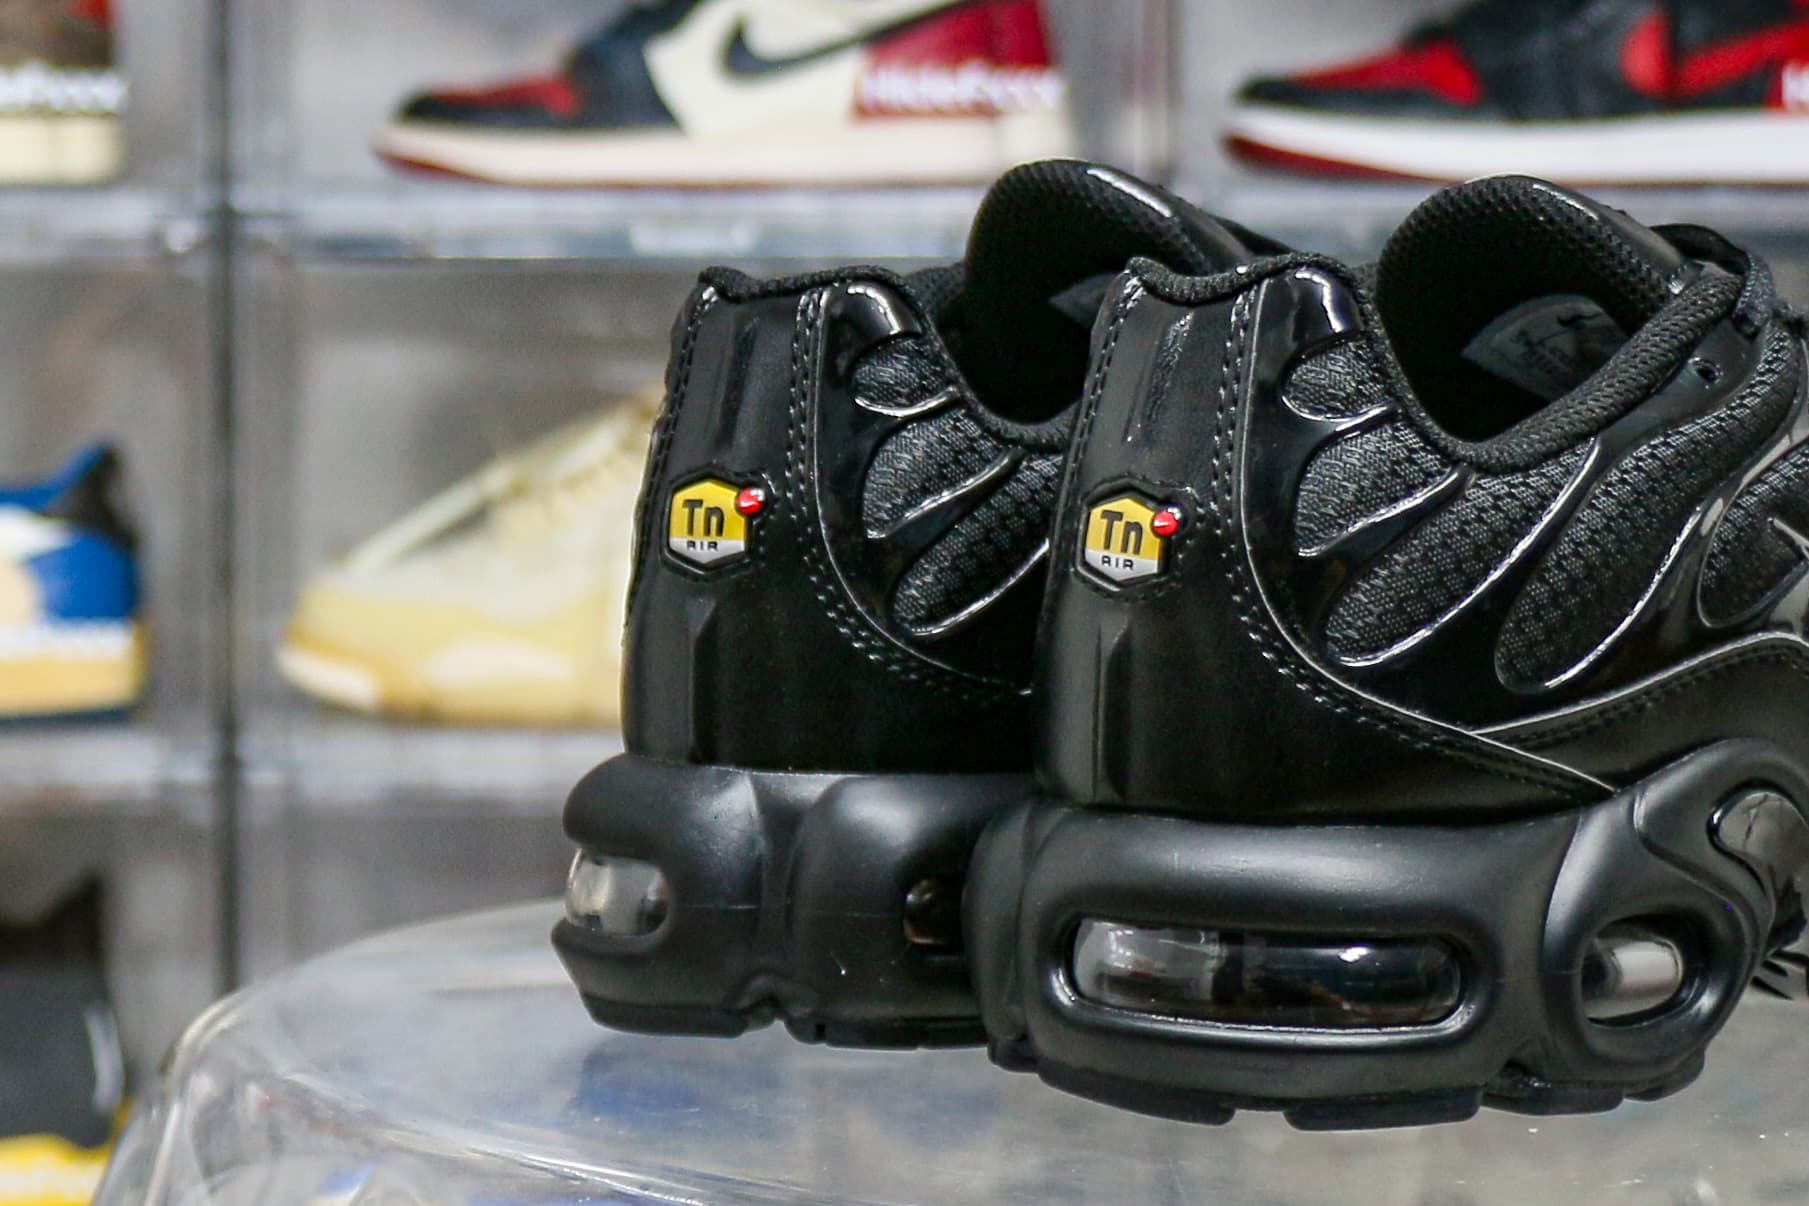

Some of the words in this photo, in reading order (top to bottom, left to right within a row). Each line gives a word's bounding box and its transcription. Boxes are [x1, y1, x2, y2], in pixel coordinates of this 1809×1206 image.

[682, 499, 725, 537] Tn
[686, 540, 718, 551] AIR
[1100, 510, 1143, 555] Tn
[1101, 555, 1134, 570] AIR
